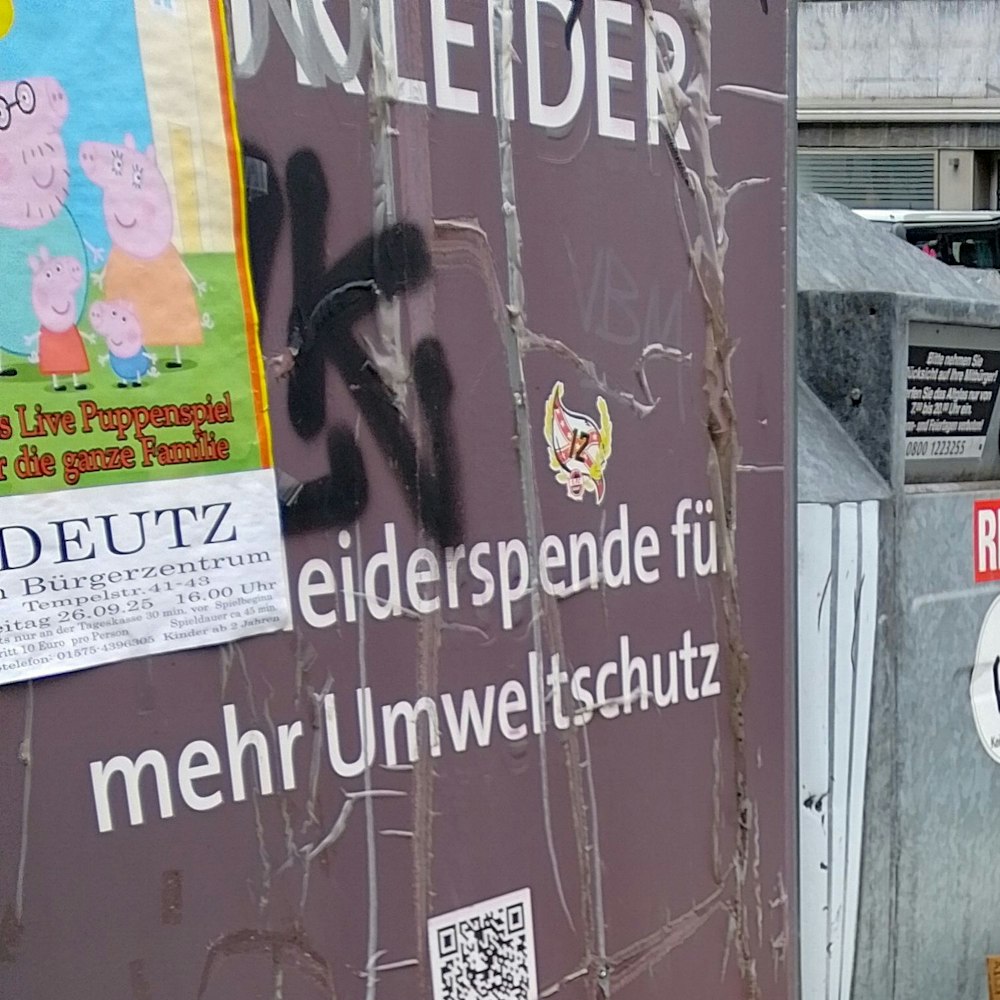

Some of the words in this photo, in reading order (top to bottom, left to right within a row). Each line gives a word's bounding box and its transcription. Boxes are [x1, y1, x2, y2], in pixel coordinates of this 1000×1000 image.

[971, 354, 984, 367] Sie
[15, 403, 76, 438] Live
[79, 391, 234, 441] Puppenspiel
[14, 444, 55, 479] die
[62, 445, 135, 485] ganze
[135, 431, 230, 467] Familie
[906, 440, 928, 456] 0800
[930, 440, 966, 456] 1223255
[0, 502, 238, 571] DEUTZ
[21, 551, 271, 597] Bürgerzentrum
[284, 503, 660, 632] eiderspende
[671, 498, 727, 578] fü
[14, 633, 37, 643] nur
[39, 630, 53, 638] an
[56, 624, 75, 635] der
[77, 615, 143, 631] Tageskasse
[146, 611, 160, 620] 30
[190, 604, 208, 613] vor
[215, 594, 273, 610] Spielbeginn
[57, 598, 154, 623] 26.09.25
[176, 586, 233, 605] 16.00
[241, 581, 277, 595] Uhr
[21, 644, 36, 654] 10
[38, 640, 65, 652] Euro
[71, 636, 90, 647] pro
[91, 628, 130, 642] Person
[170, 612, 227, 629] Spieldauer
[230, 611, 241, 619] ca
[244, 607, 256, 616] 45
[163, 628, 209, 641] Kinder
[212, 624, 228, 634] ab
[230, 622, 239, 630] 2
[241, 615, 280, 628] Jahren
[89, 704, 303, 833] mehr
[323, 629, 720, 777] Umweltschutz
